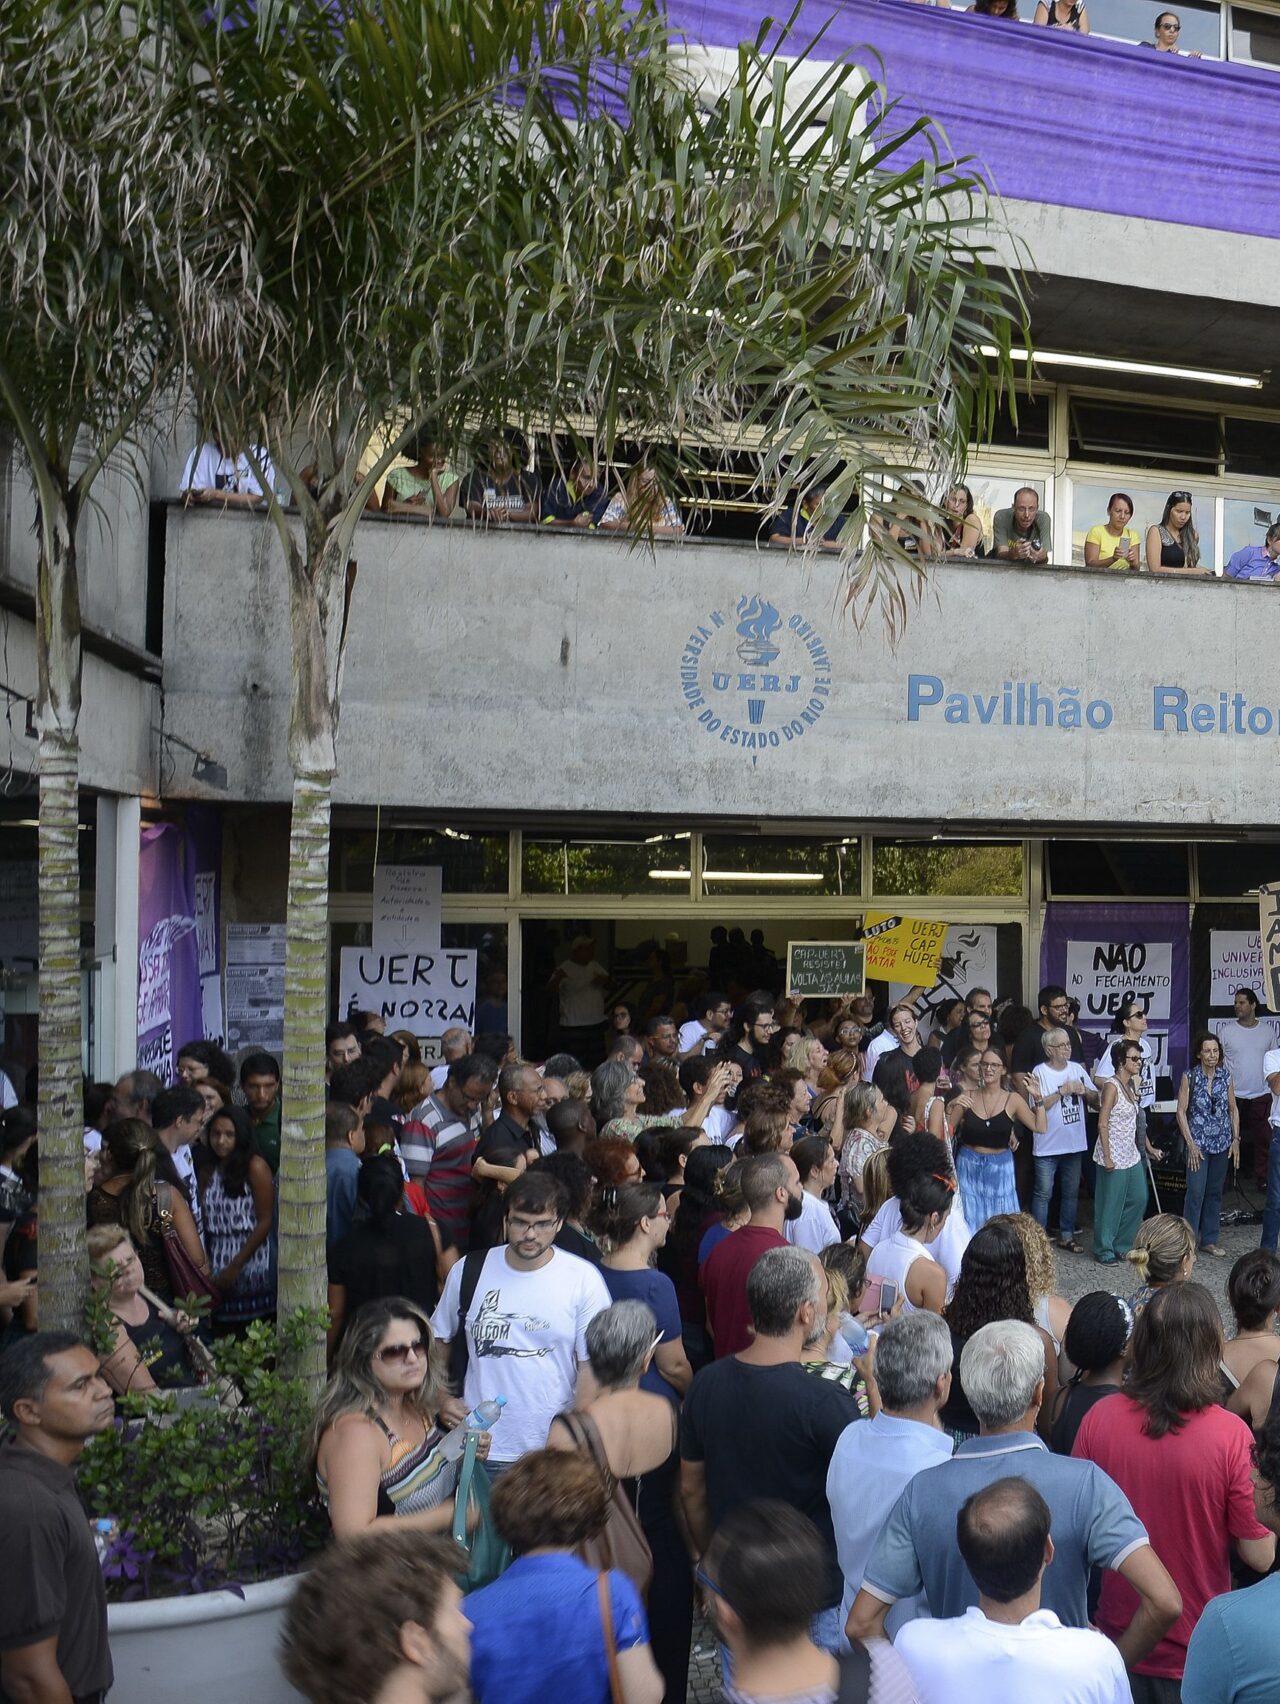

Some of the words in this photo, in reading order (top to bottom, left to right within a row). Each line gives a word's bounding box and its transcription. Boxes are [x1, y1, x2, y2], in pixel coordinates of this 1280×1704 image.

[789, 614, 831, 672] JANEIRO
[712, 672, 801, 693] UERJ
[815, 677, 832, 696] DE
[800, 698, 825, 725] RIO
[908, 675, 1113, 729] Pavilhão
[698, 709, 721, 733] DO
[782, 720, 803, 741] DO
[720, 725, 779, 748] ESTADO
[864, 918, 897, 939] LUTO
[911, 921, 946, 938] UERJ
[910, 938, 937, 952] CAP
[902, 950, 936, 968] HUPE
[1092, 943, 1147, 973] NÃO
[791, 972, 818, 986] VOLTA
[834, 972, 861, 984] AULAS
[1072, 974, 1083, 985] AO
[1095, 974, 1170, 988] FECHAMENTO
